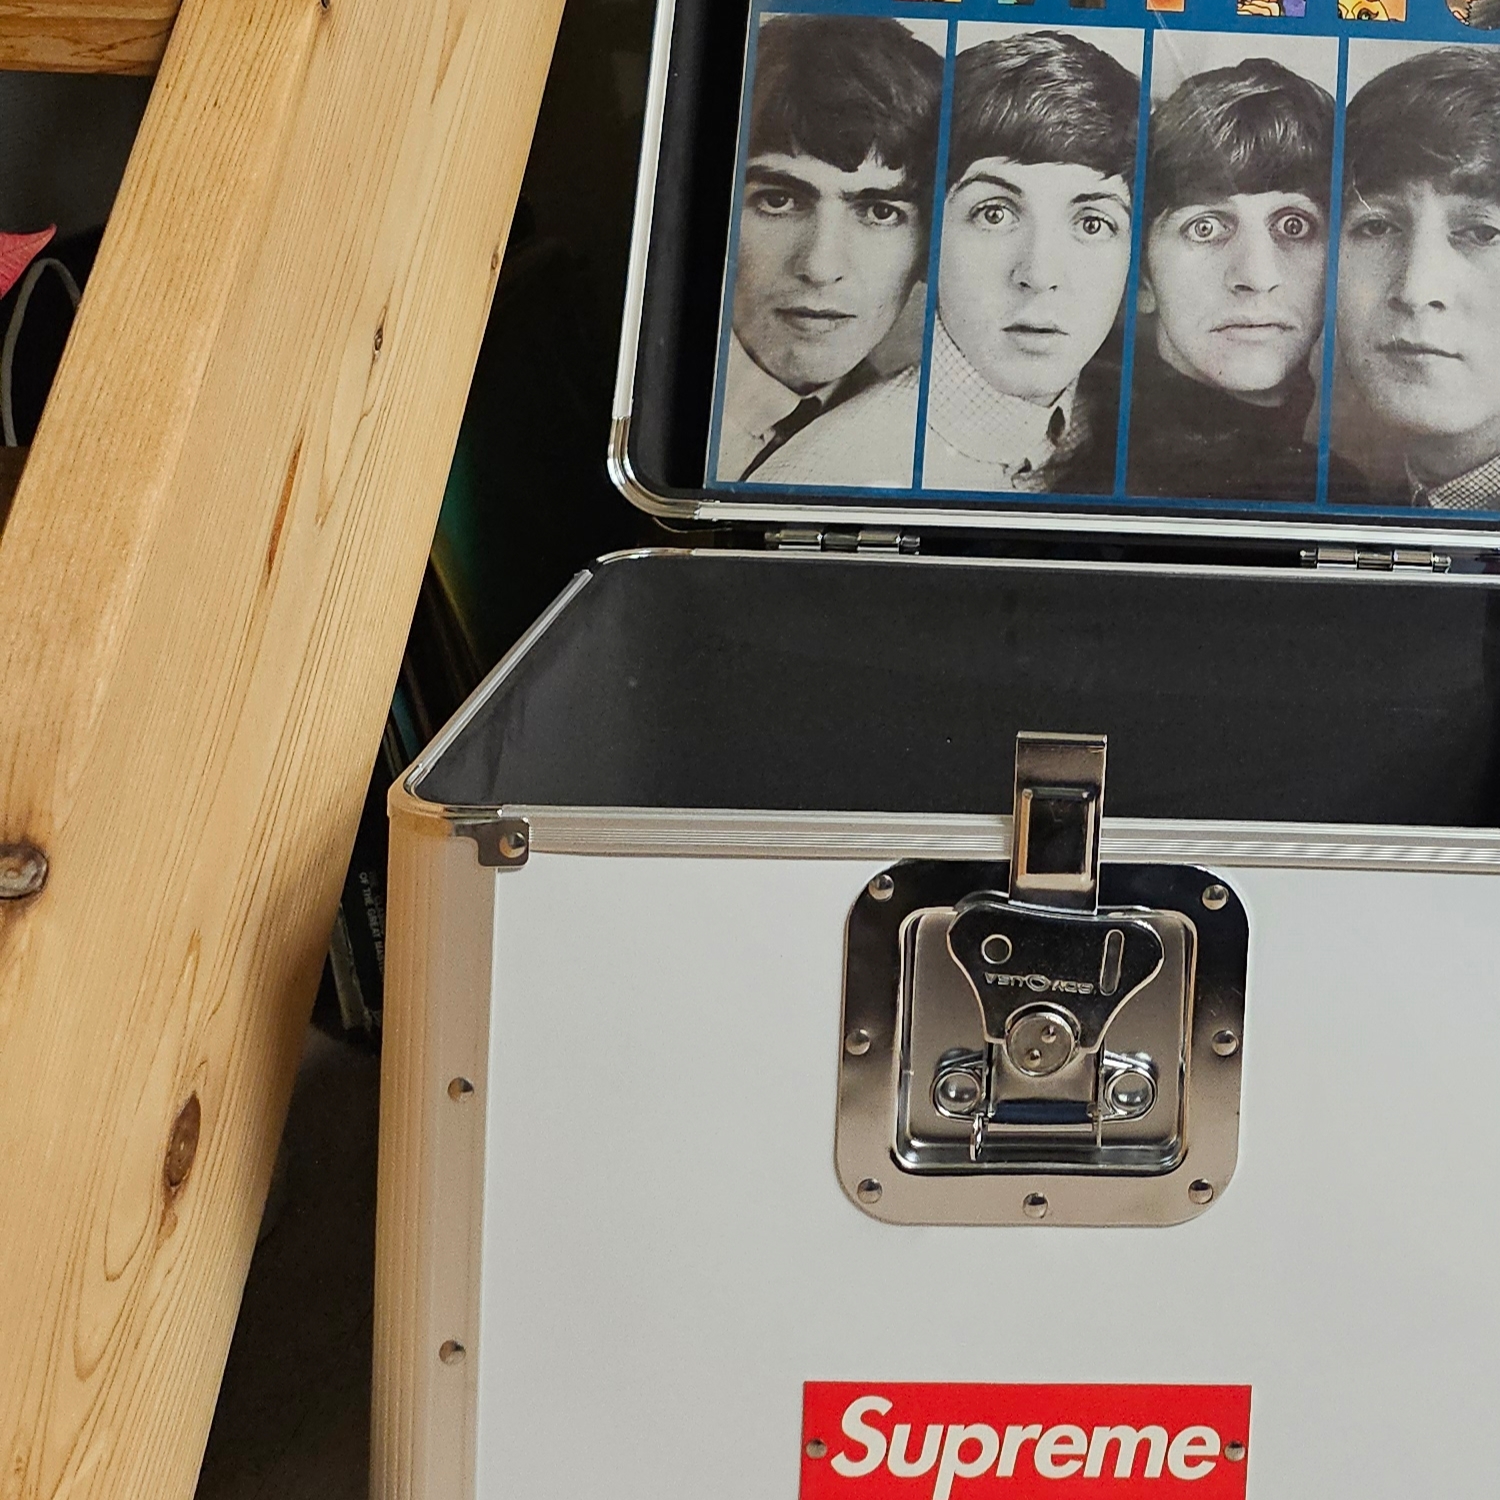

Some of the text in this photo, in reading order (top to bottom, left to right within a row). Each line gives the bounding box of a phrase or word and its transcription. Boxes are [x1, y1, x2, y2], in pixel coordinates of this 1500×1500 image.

[358, 871, 370, 886] OF
[362, 886, 375, 907] THE
[830, 1394, 1221, 1500] Supreme
